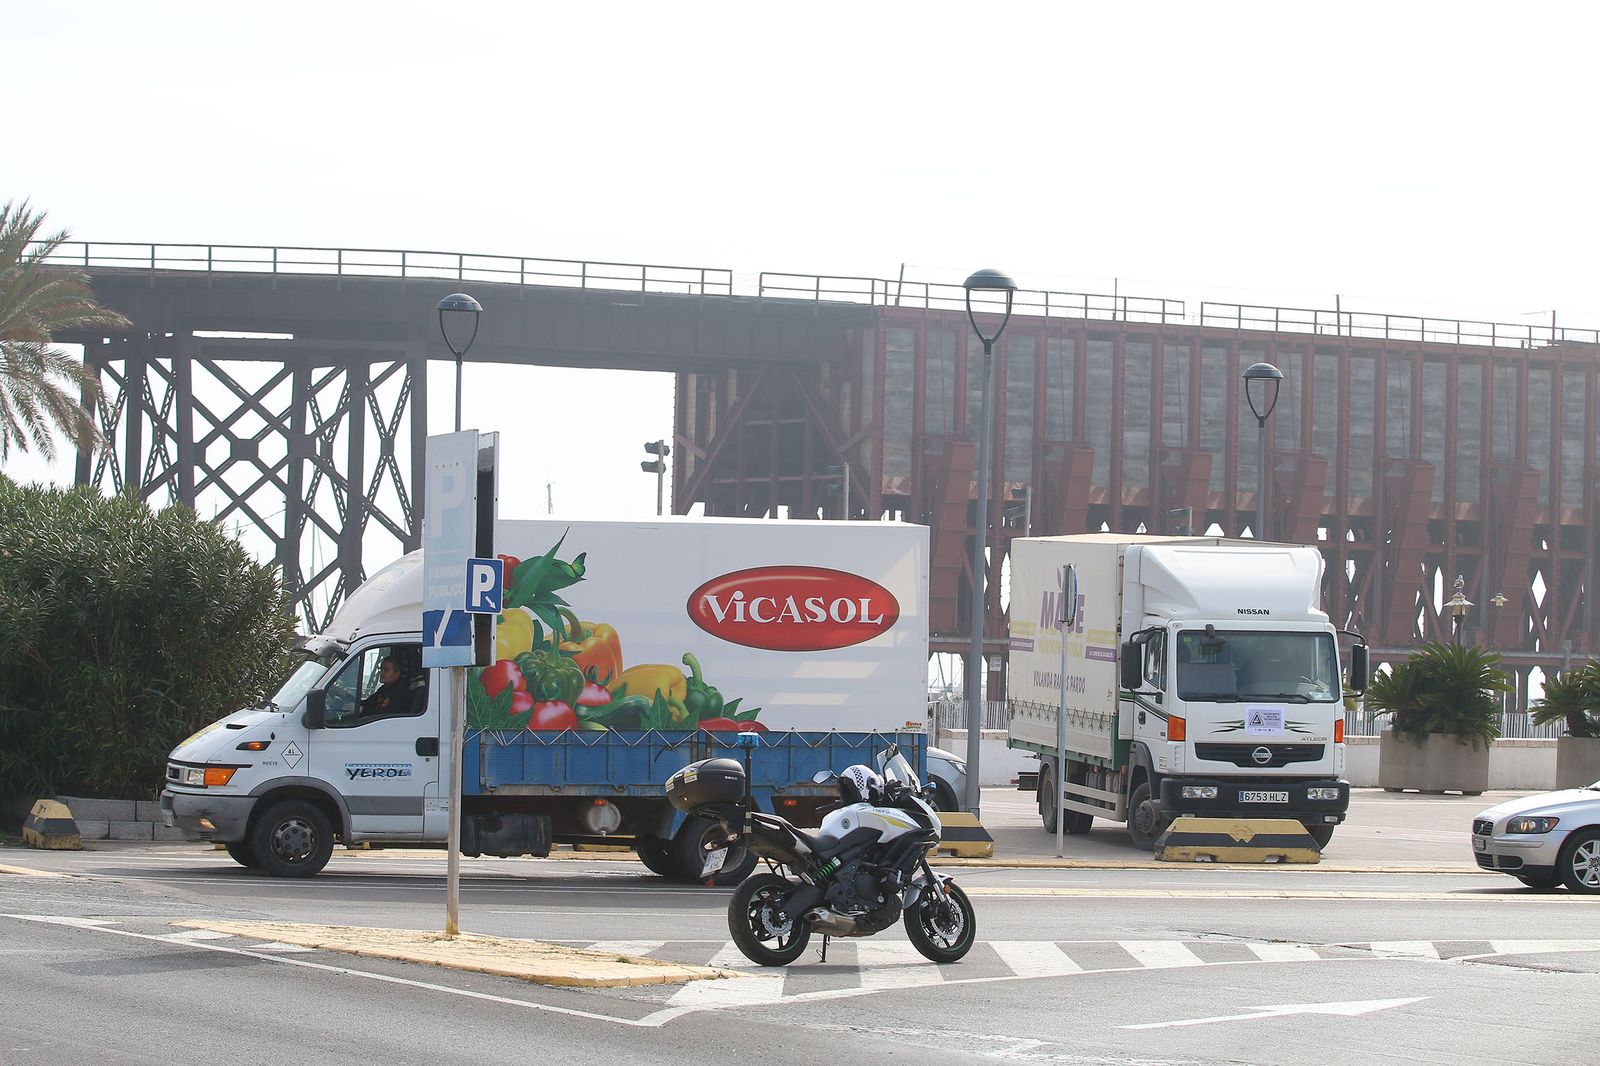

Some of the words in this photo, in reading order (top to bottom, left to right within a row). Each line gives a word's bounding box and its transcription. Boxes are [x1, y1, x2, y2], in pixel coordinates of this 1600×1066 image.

[430, 462, 467, 538] P
[472, 564, 496, 607] P
[1244, 792, 1268, 801] 6753
[1269, 793, 1287, 802] HLZ
